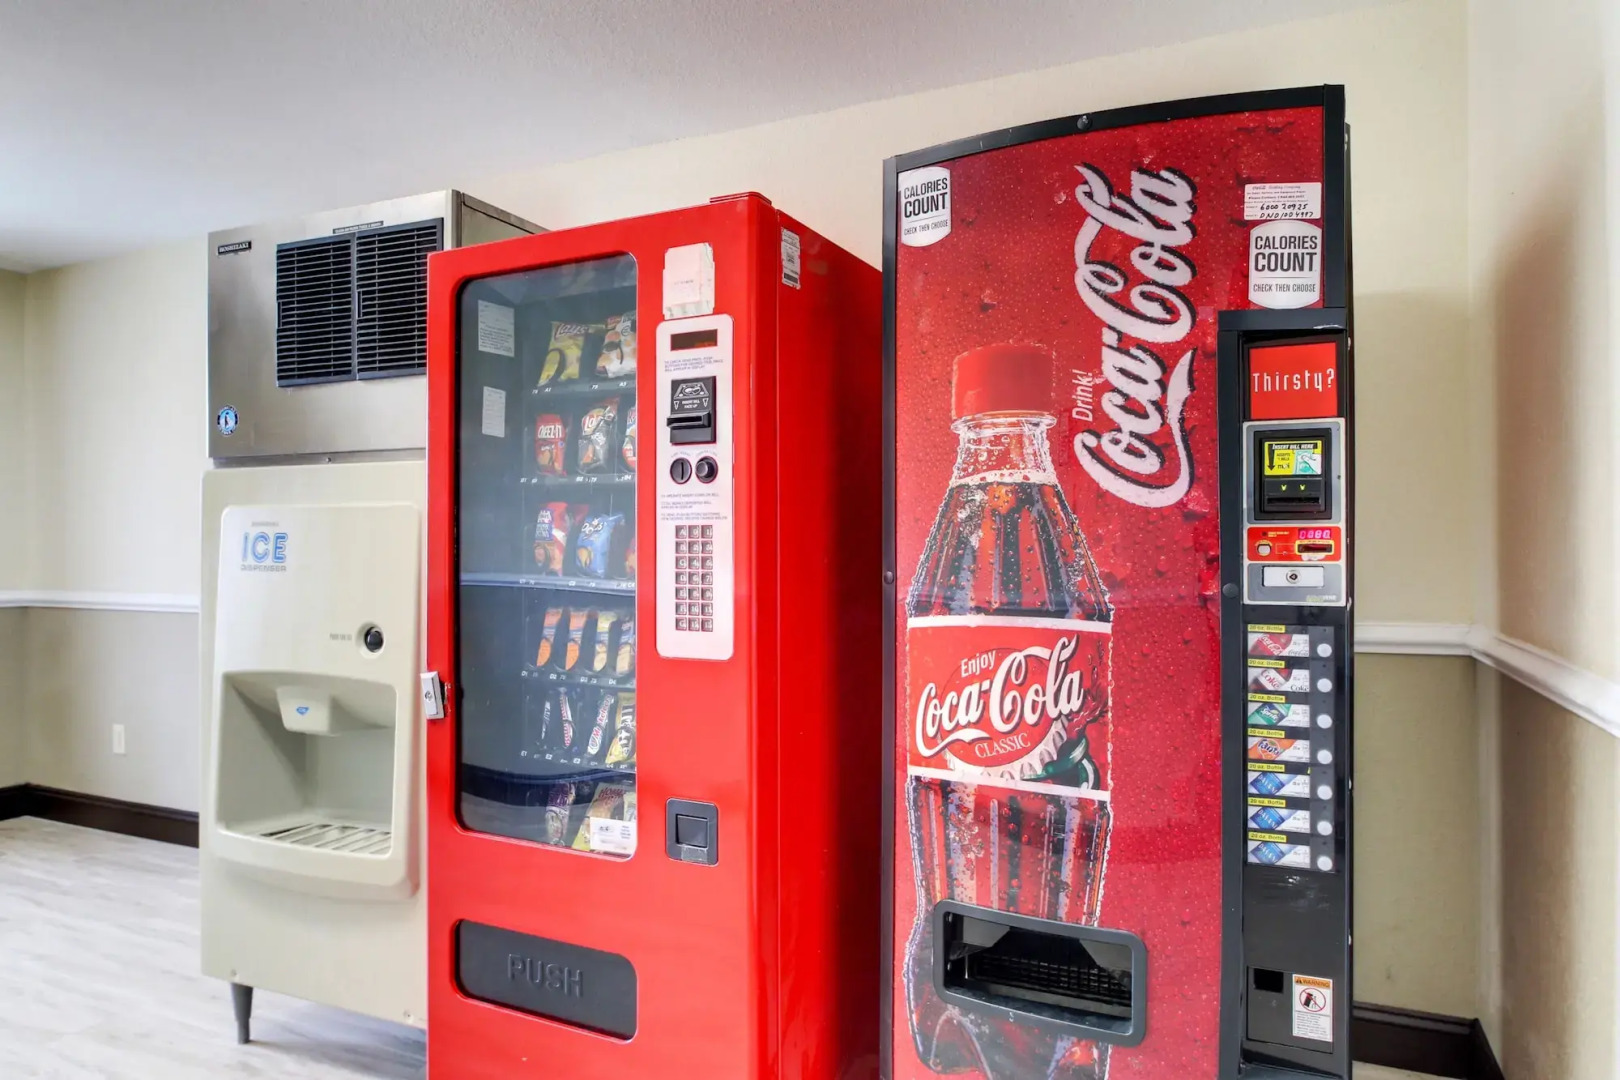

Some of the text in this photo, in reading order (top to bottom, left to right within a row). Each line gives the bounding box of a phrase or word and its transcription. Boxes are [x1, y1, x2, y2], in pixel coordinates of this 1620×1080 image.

[904, 177, 948, 200] CALORIES
[904, 192, 948, 218] COUNT
[904, 219, 948, 236] CHECK THEN CHOOSE
[1254, 235, 1318, 250] CALORIES
[1254, 252, 1318, 272] COUNT
[1253, 283, 1316, 293] CHECK THEN CHOOSE
[1073, 161, 1198, 509] Coca-Cola
[1252, 368, 1335, 393] Thirsty?
[1072, 370, 1094, 422] Drink!
[242, 532, 289, 563] ICE
[960, 650, 997, 678] Enjoy
[1261, 669, 1280, 689] Coke
[1290, 684, 1309, 692] Coke
[915, 634, 1084, 757] Coca-Cola
[974, 732, 1031, 758] CLASSIC
[507, 953, 583, 999] PUSH
